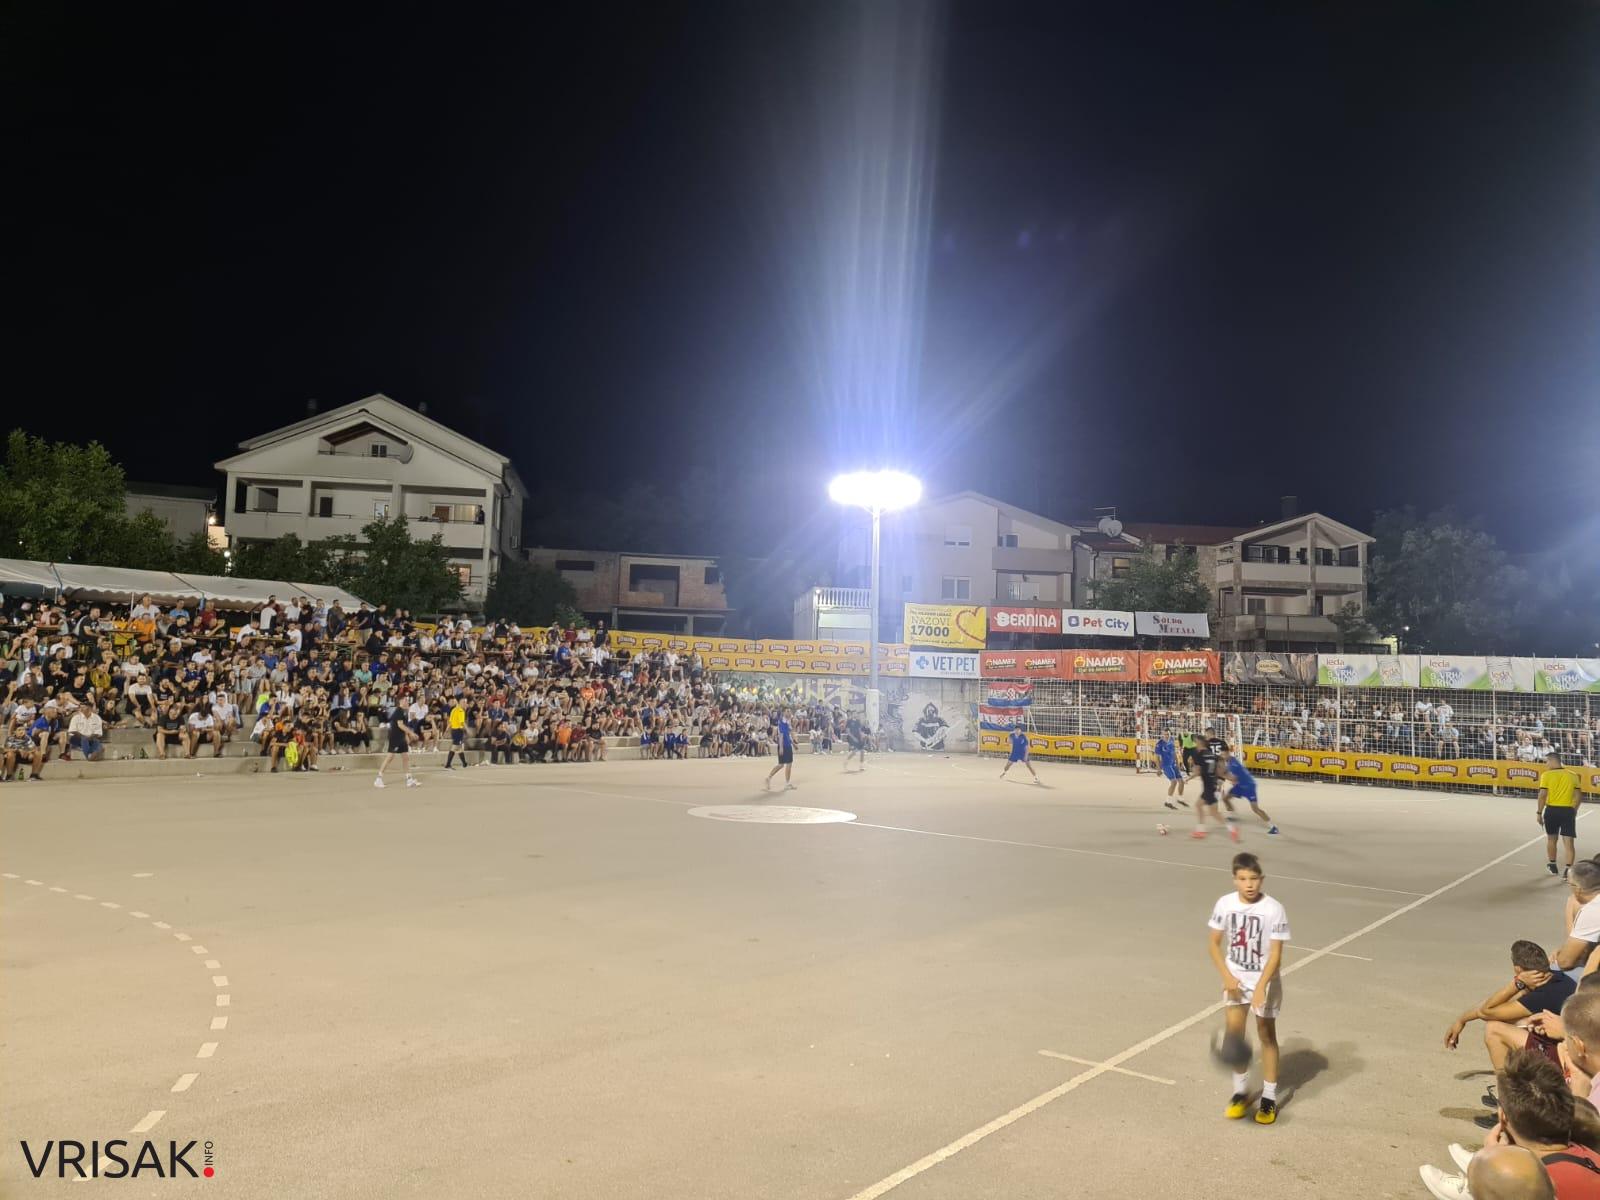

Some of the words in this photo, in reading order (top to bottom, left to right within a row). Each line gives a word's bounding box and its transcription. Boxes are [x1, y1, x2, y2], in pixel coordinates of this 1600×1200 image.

[911, 616, 951, 626] NAZOVI
[994, 612, 1057, 627] BERNINA
[1083, 618, 1102, 628] Pet
[1105, 618, 1129, 631] City
[910, 625, 949, 637] 17000
[932, 656, 953, 671] VET
[956, 658, 976, 671] PET
[992, 658, 1017, 666] NAMEX
[1031, 658, 1057, 666] NAMEX
[1086, 656, 1125, 667] NAMEX
[1164, 658, 1208, 669] NAMEX
[1210, 745, 1222, 755] 15
